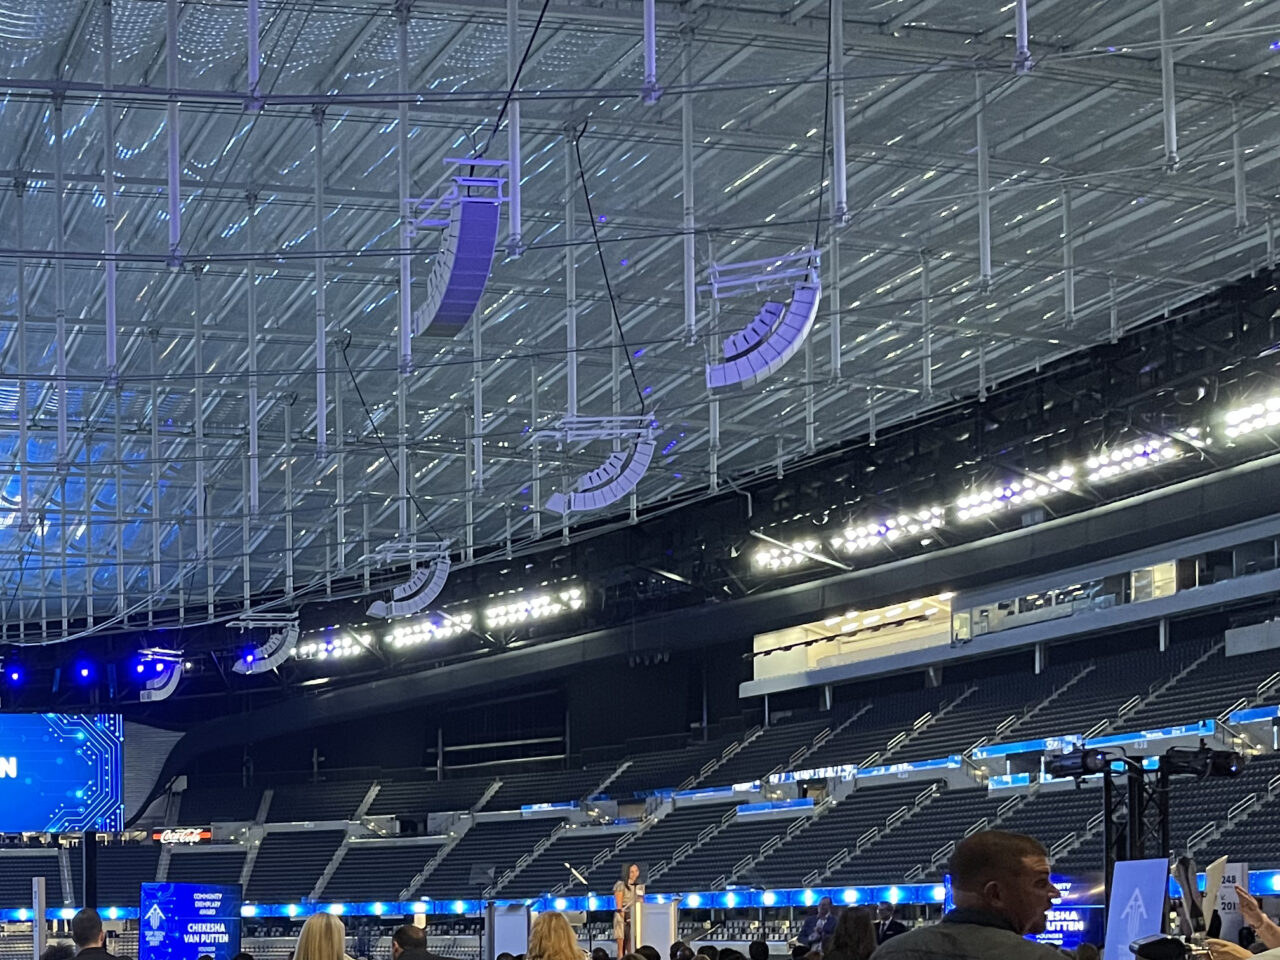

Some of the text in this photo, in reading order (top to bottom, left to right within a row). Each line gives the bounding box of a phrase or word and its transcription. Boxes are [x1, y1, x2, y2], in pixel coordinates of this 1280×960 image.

[160, 828, 203, 843] Coca-Cola
[187, 923, 226, 932] CHEKESHA
[1046, 921, 1084, 931] UTTEN
[183, 934, 229, 943] VAN PUTTEN
